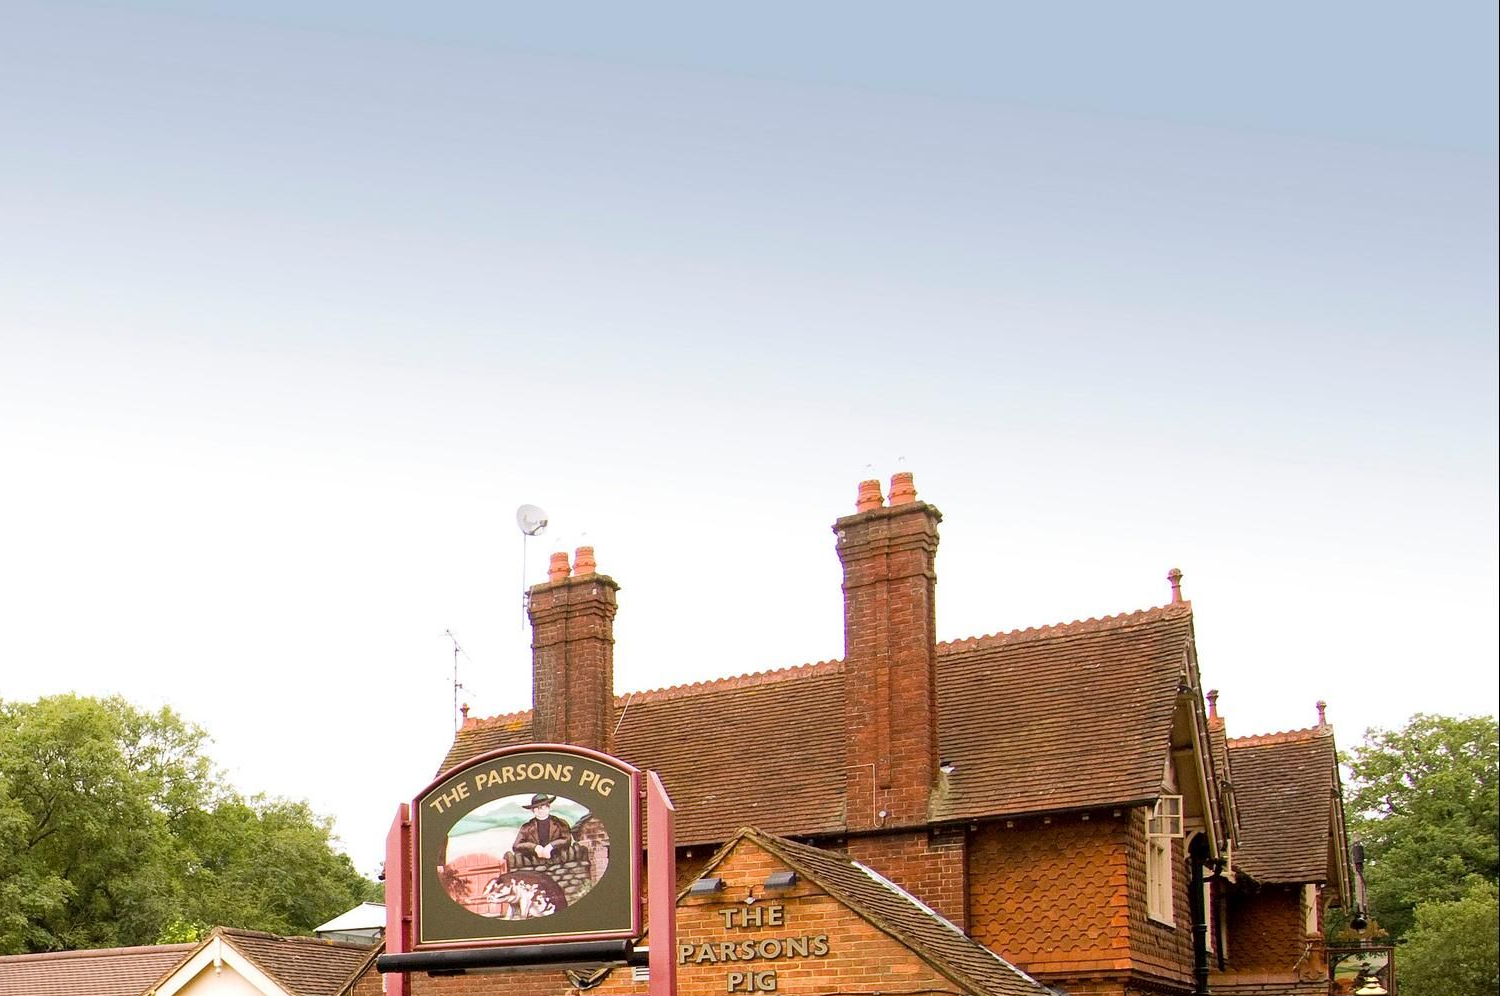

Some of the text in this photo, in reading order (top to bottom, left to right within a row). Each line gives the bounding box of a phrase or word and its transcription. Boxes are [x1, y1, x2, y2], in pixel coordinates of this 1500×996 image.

[429, 762, 616, 815] THE PARSONS PIG
[718, 904, 785, 929] THE
[678, 935, 829, 965] PARSONS
[726, 970, 777, 993] PIG
